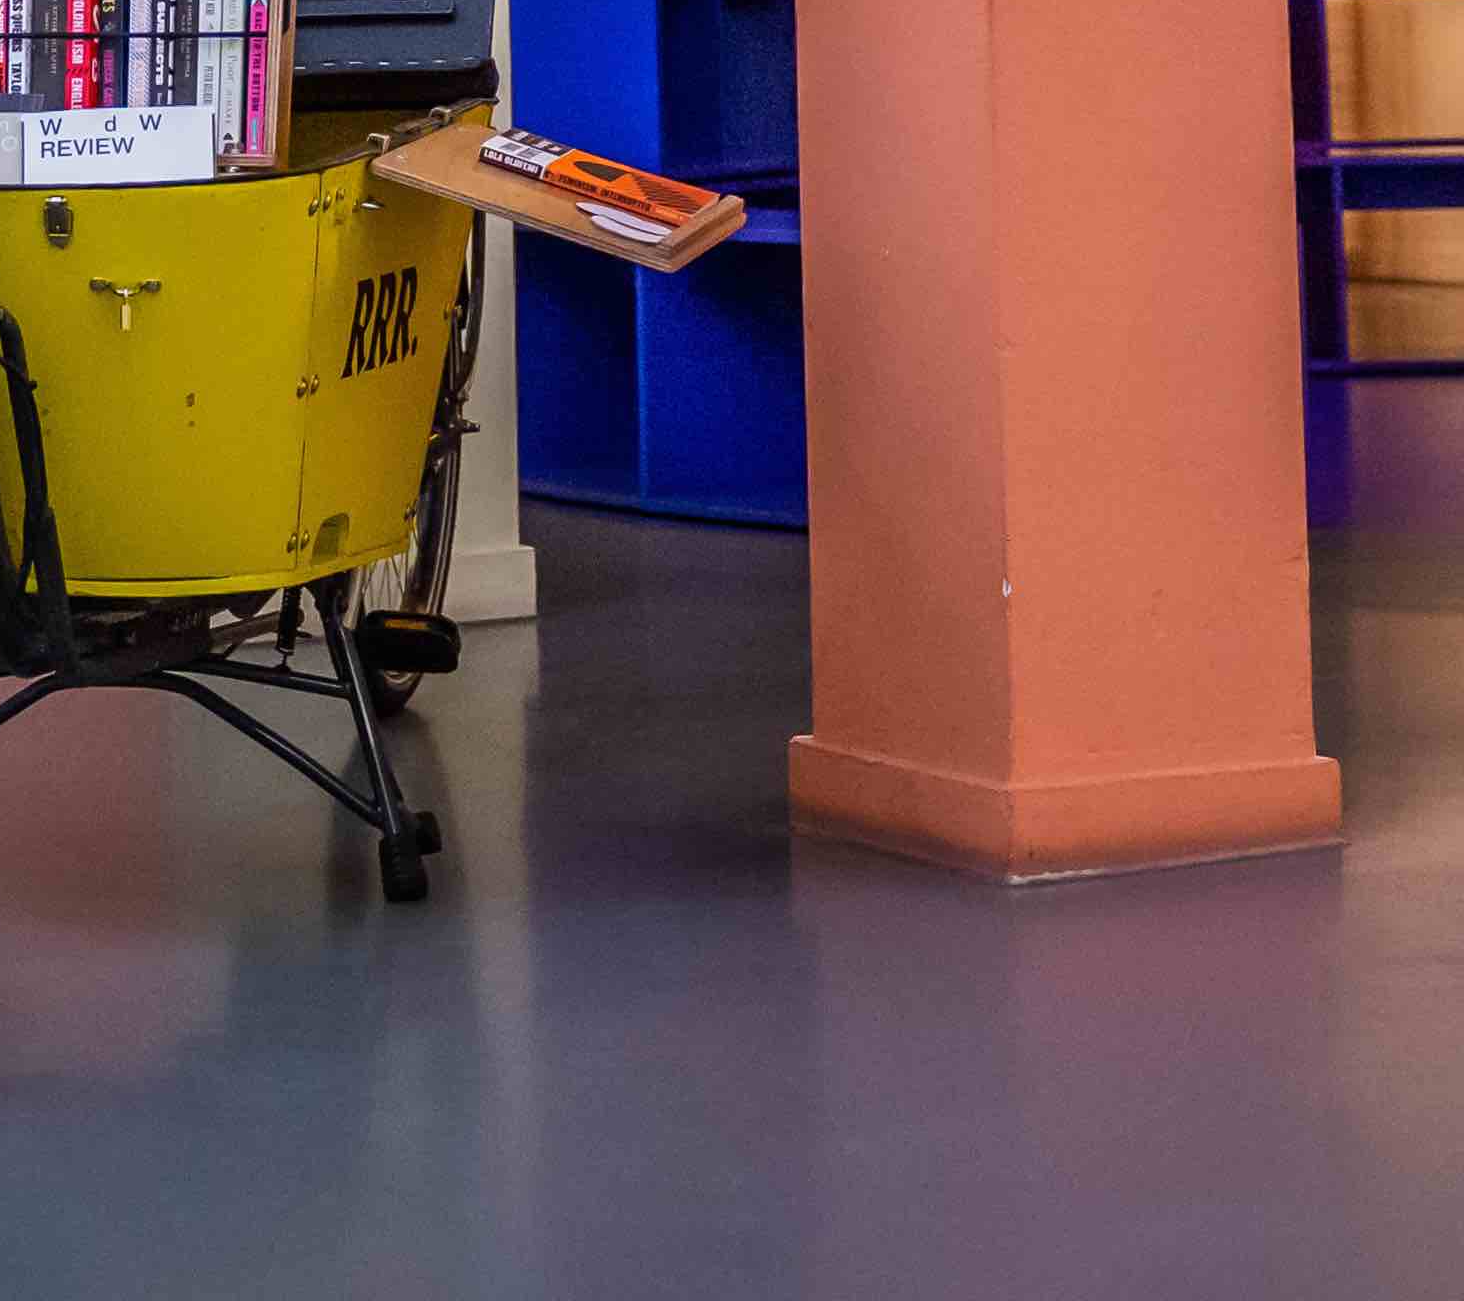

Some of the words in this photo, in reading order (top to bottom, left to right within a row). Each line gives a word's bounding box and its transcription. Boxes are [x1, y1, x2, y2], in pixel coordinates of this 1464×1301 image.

[9, 14, 23, 52] QUERS
[10, 62, 22, 95] TAYLO
[40, 137, 134, 158] REVIEW
[484, 149, 504, 162] LOLA
[341, 267, 417, 379] RRR.
